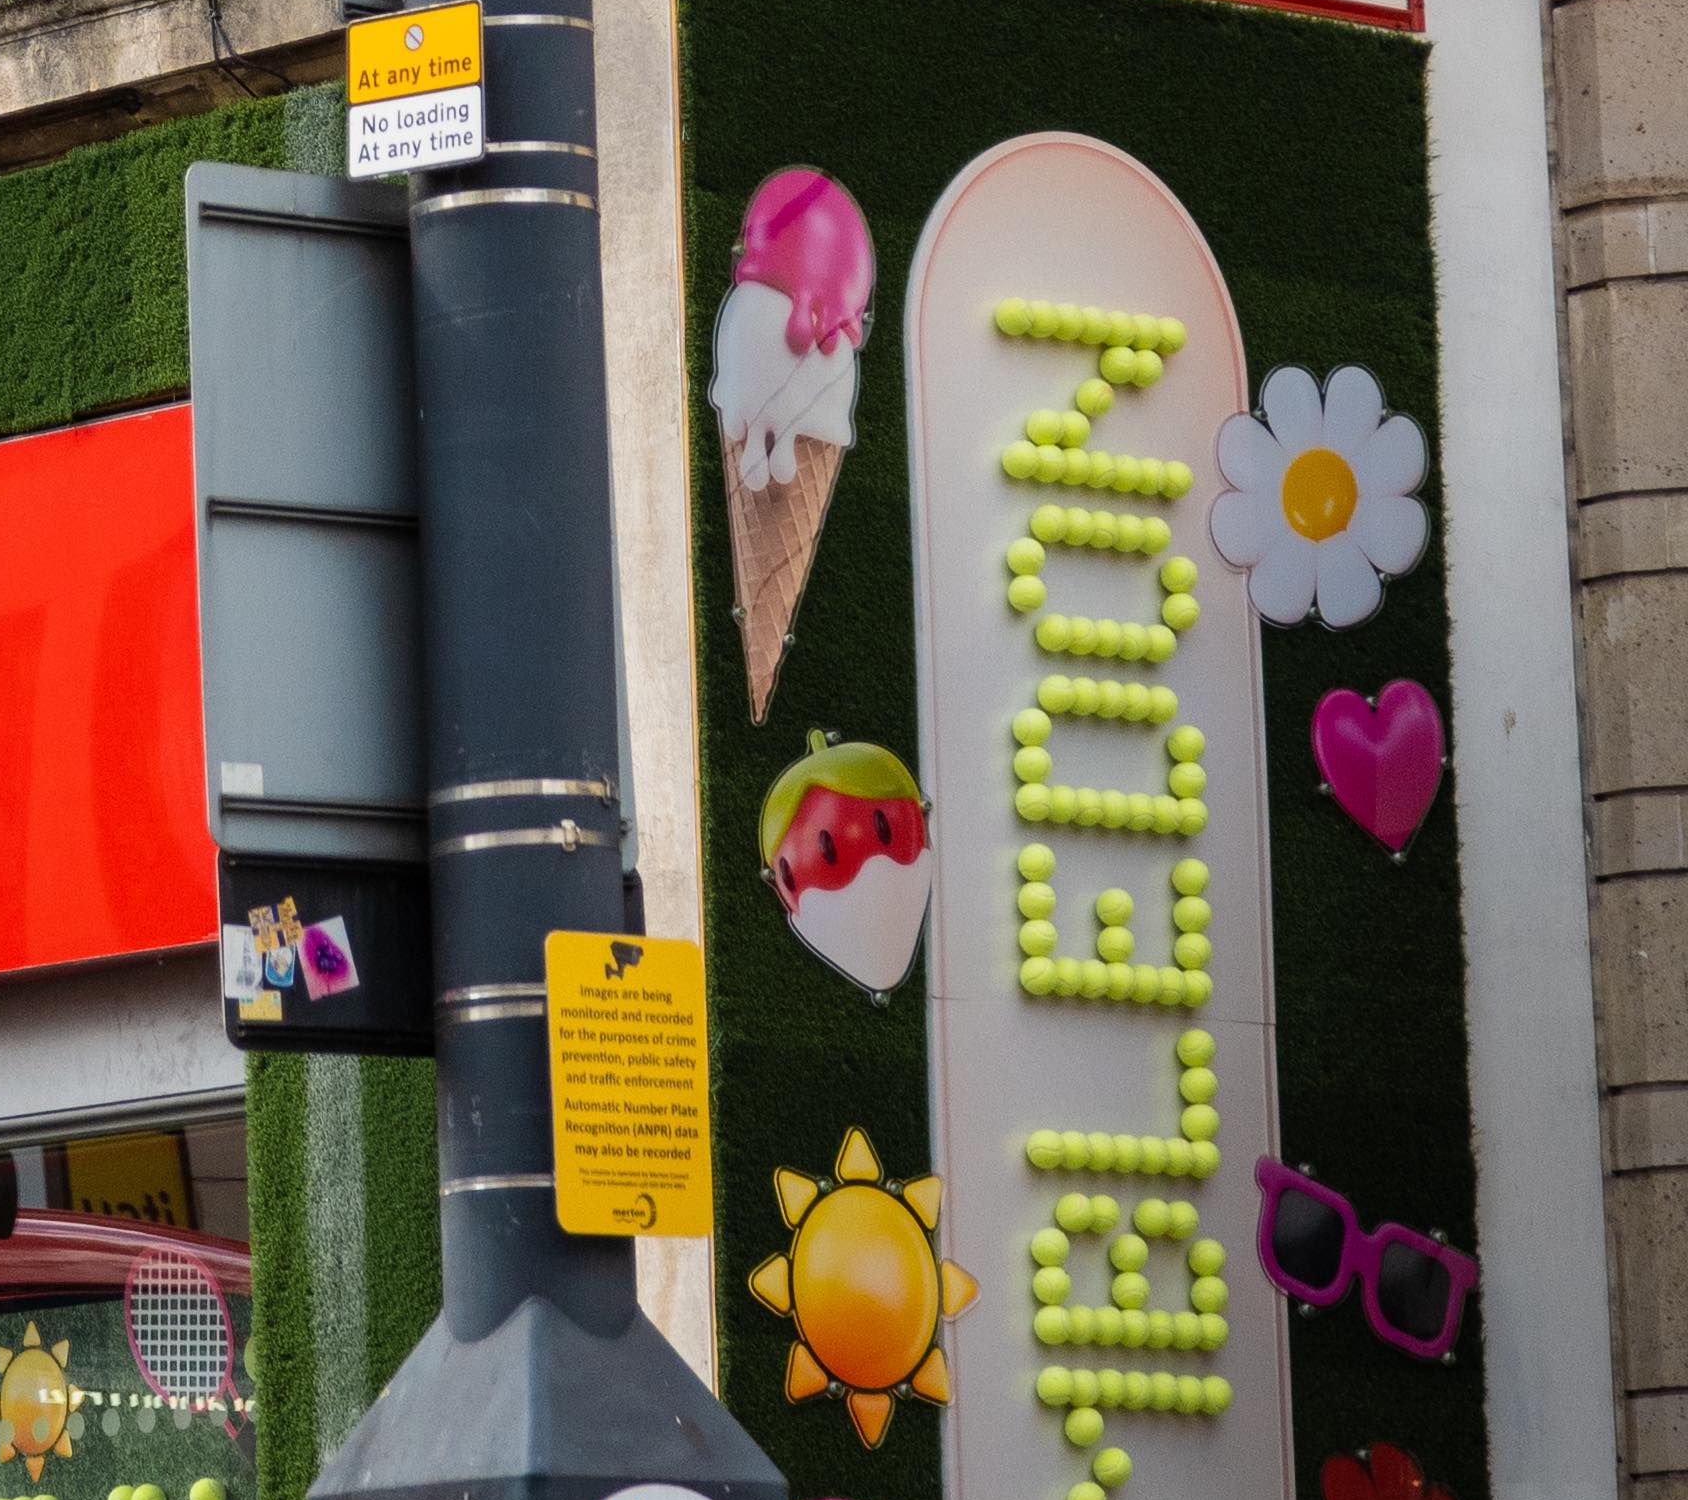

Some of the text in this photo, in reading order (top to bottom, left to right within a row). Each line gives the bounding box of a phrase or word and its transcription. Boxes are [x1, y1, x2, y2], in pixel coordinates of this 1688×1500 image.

[358, 56, 472, 90] At any time
[362, 102, 470, 135] No loading
[358, 130, 473, 163] At any time
[580, 984, 673, 1004] Images are being
[560, 1006, 693, 1025] monitored and recorded
[559, 1027, 697, 1047] for the purposes of crime
[561, 1051, 696, 1070] prevention, public safety
[566, 1072, 694, 1090] and traffic enforcement
[564, 1098, 698, 1117] Automatic Number Plate
[565, 1120, 699, 1140] Recognition (ANPR) data
[575, 1145, 691, 1160] may also be recorded
